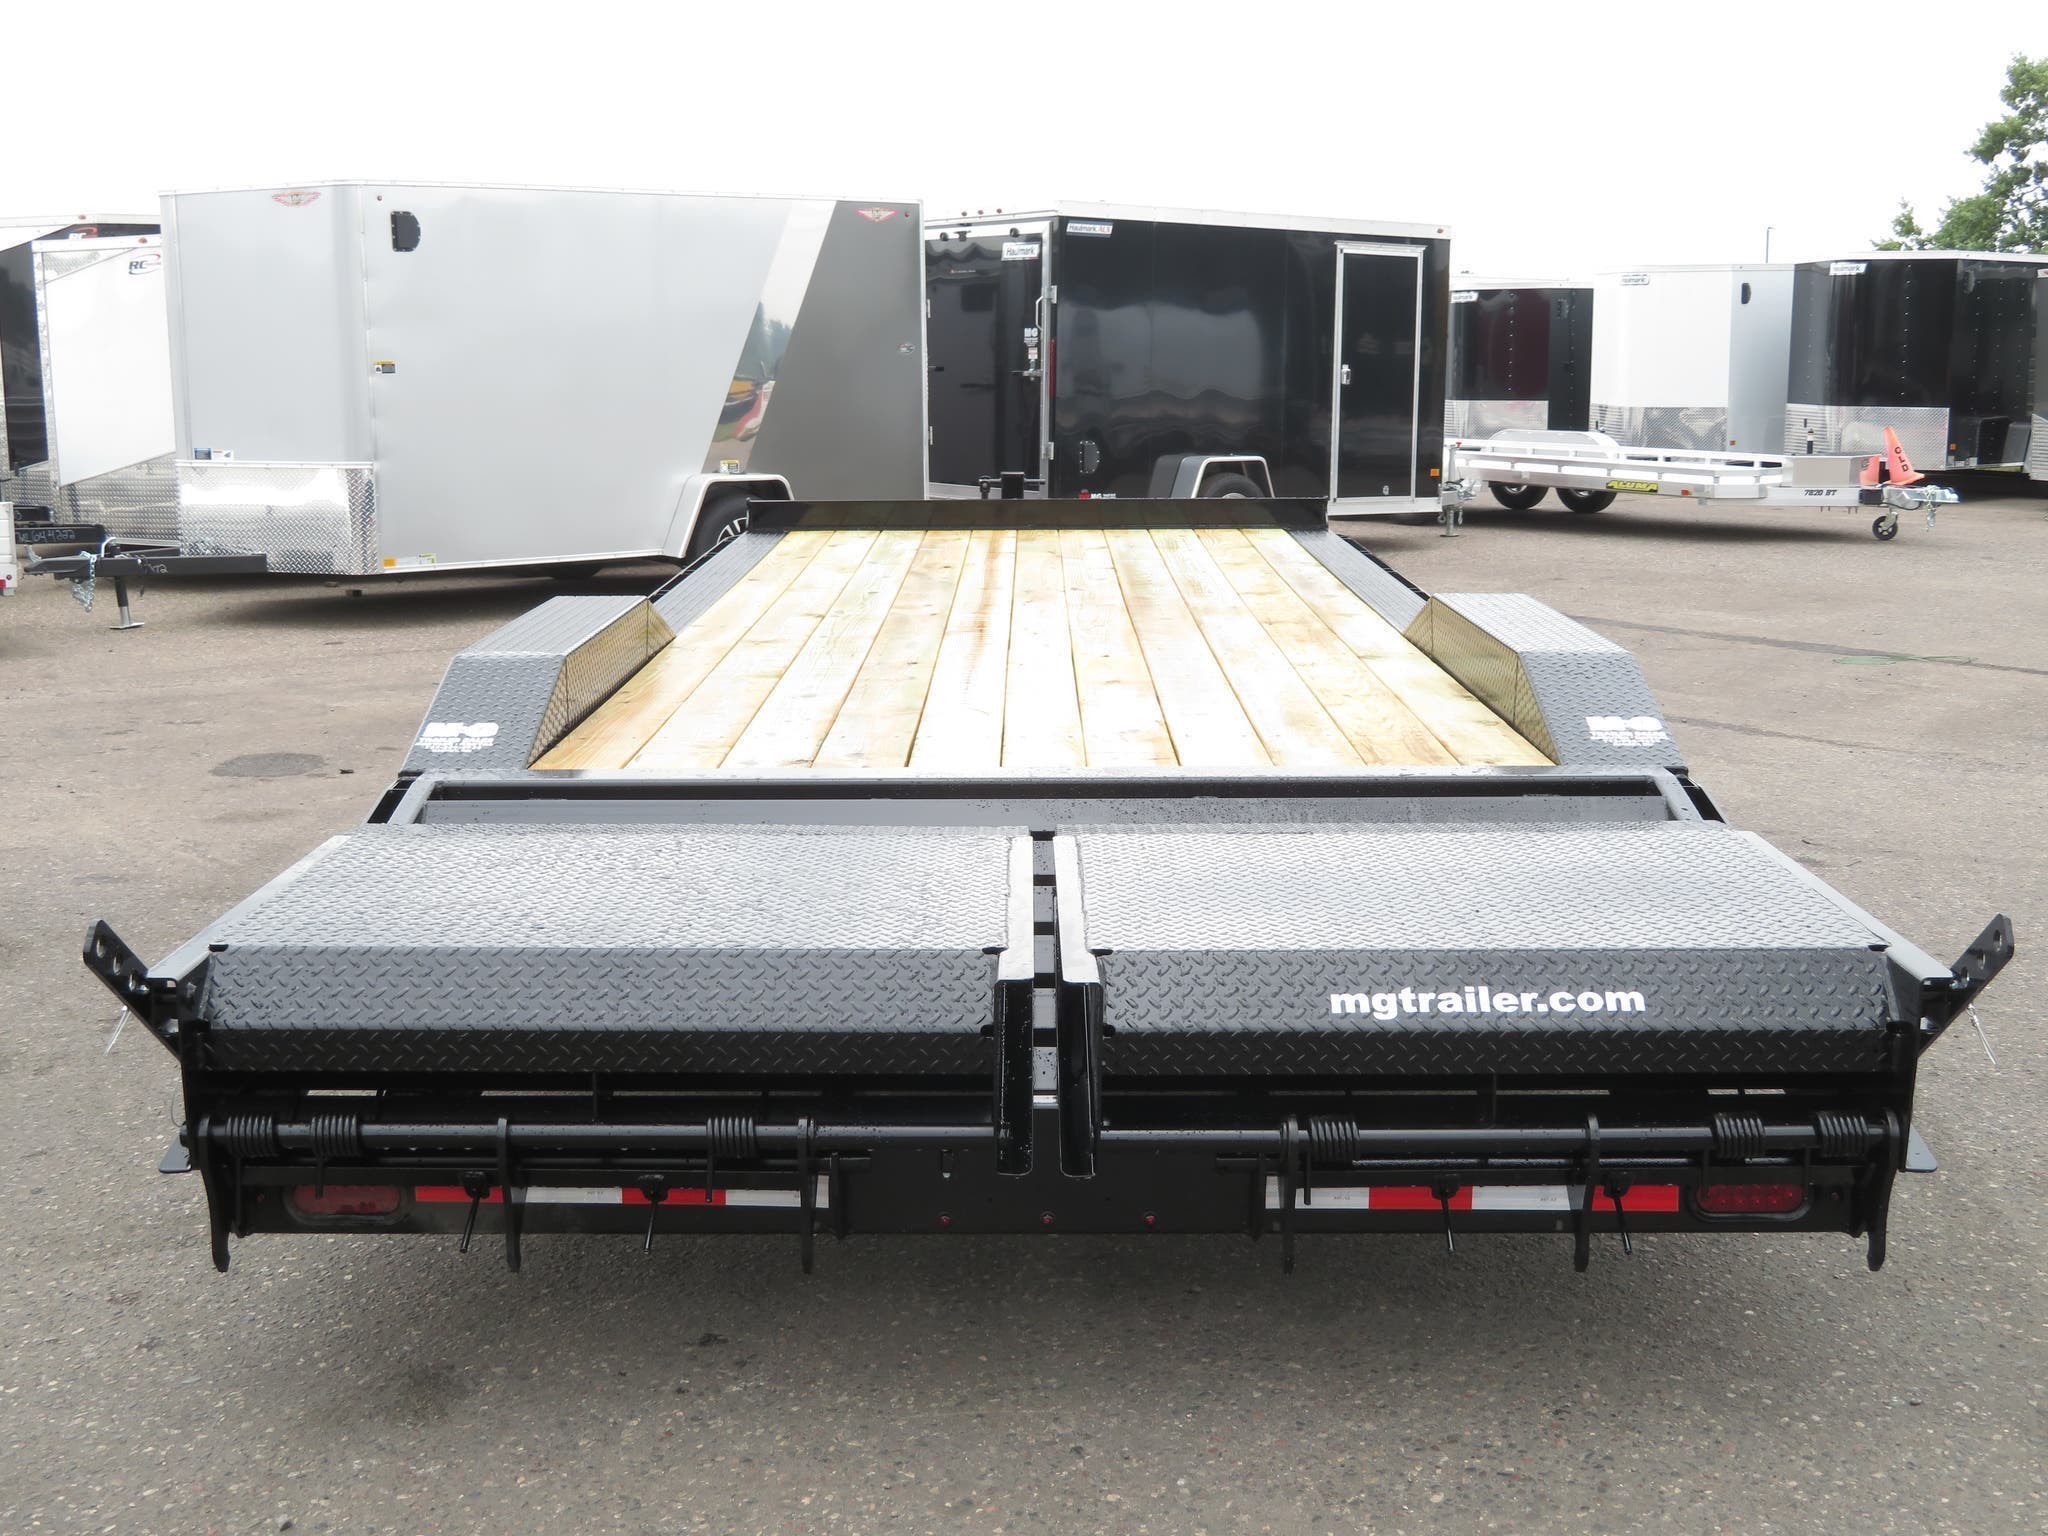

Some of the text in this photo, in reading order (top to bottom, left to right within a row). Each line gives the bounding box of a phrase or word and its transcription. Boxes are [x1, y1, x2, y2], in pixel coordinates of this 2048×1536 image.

[1006, 246, 1035, 257] Haulmark
[128, 260, 148, 270] RC
[1608, 480, 1658, 491] ALUMA
[1330, 986, 1646, 1020] mgtrailer.com
